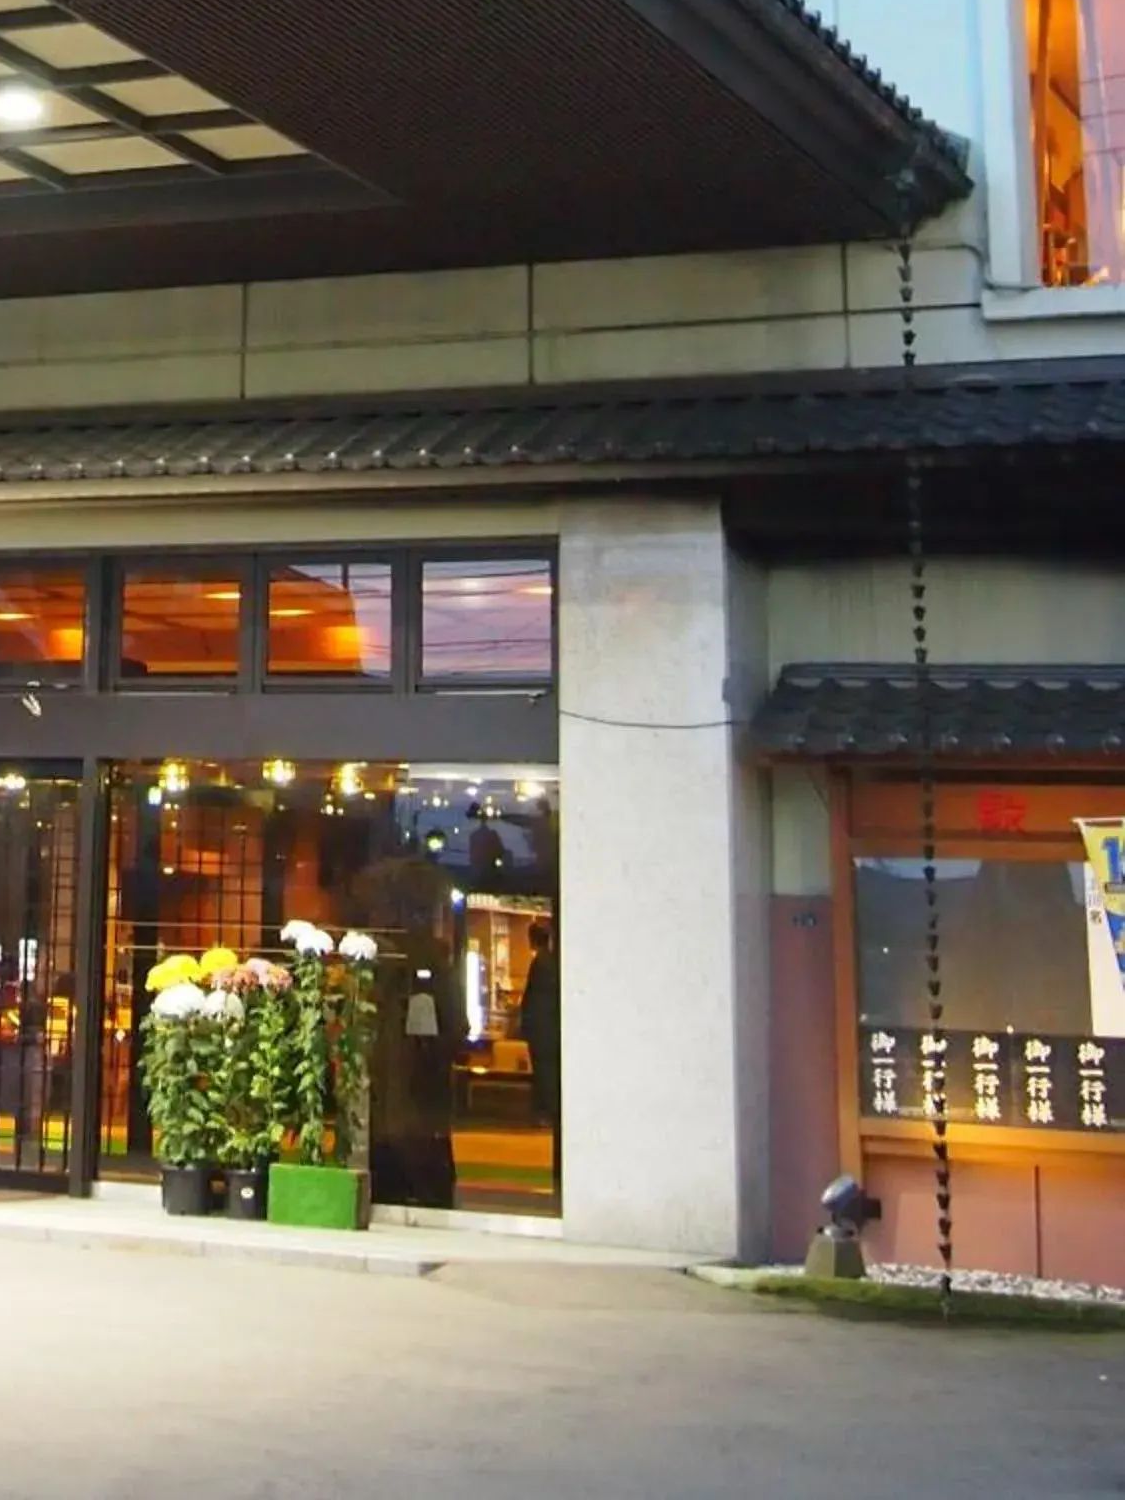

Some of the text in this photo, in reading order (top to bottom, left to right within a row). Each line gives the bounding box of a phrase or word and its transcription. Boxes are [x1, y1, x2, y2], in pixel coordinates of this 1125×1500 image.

[871, 1031, 897, 1114] 御一行様
[972, 1036, 1001, 1122] 御一行様
[1025, 1039, 1053, 1124] 御一行様
[1078, 1041, 1107, 1127] 御一行様
